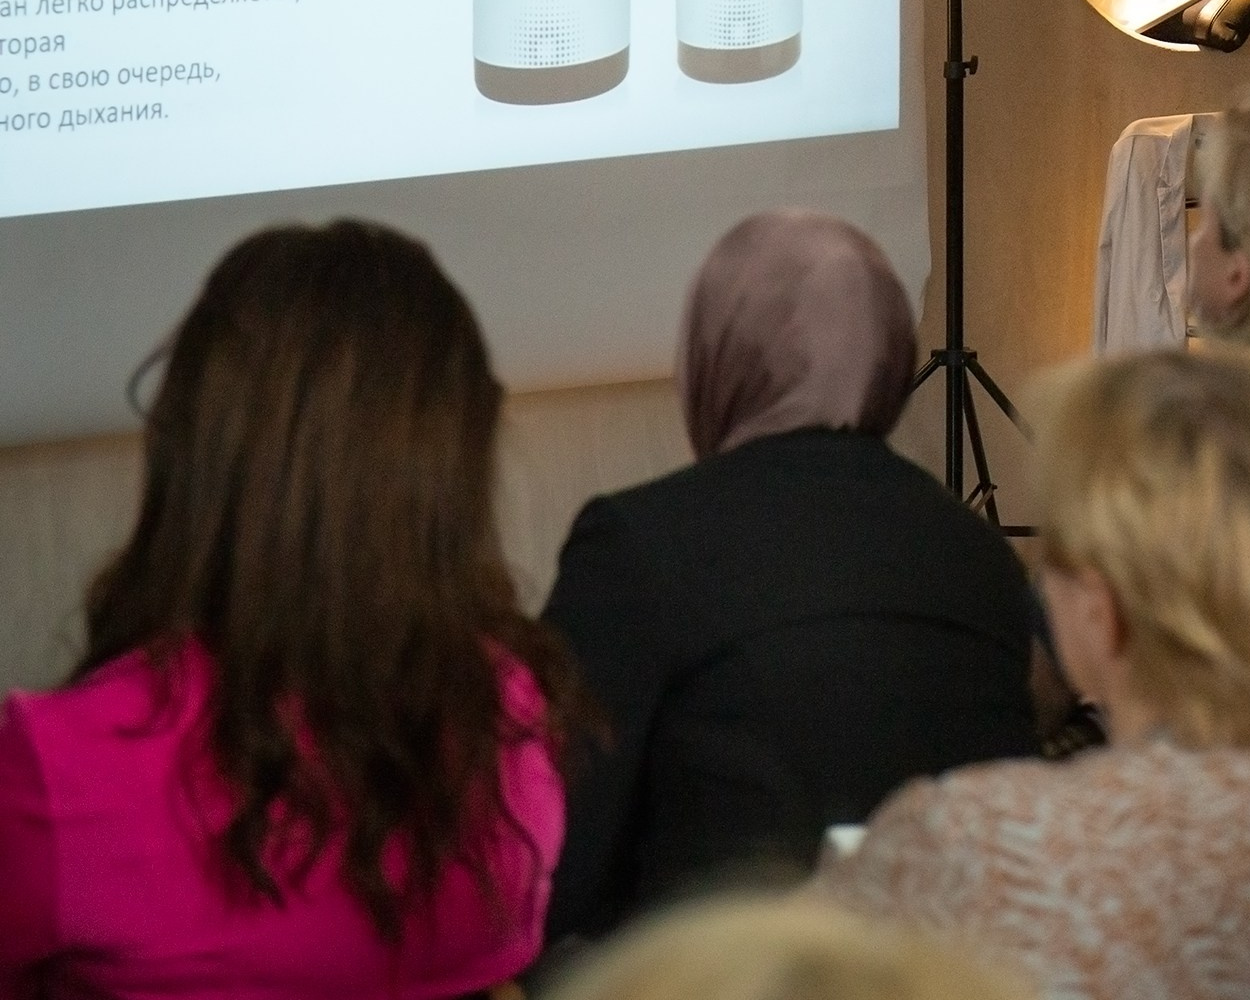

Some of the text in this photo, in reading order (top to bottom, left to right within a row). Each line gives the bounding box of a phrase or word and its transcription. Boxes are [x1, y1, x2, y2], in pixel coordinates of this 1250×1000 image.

[28, 73, 41, 92] в
[48, 68, 110, 91] свою
[117, 62, 221, 87] очередь,
[57, 102, 169, 132] дыхания.
